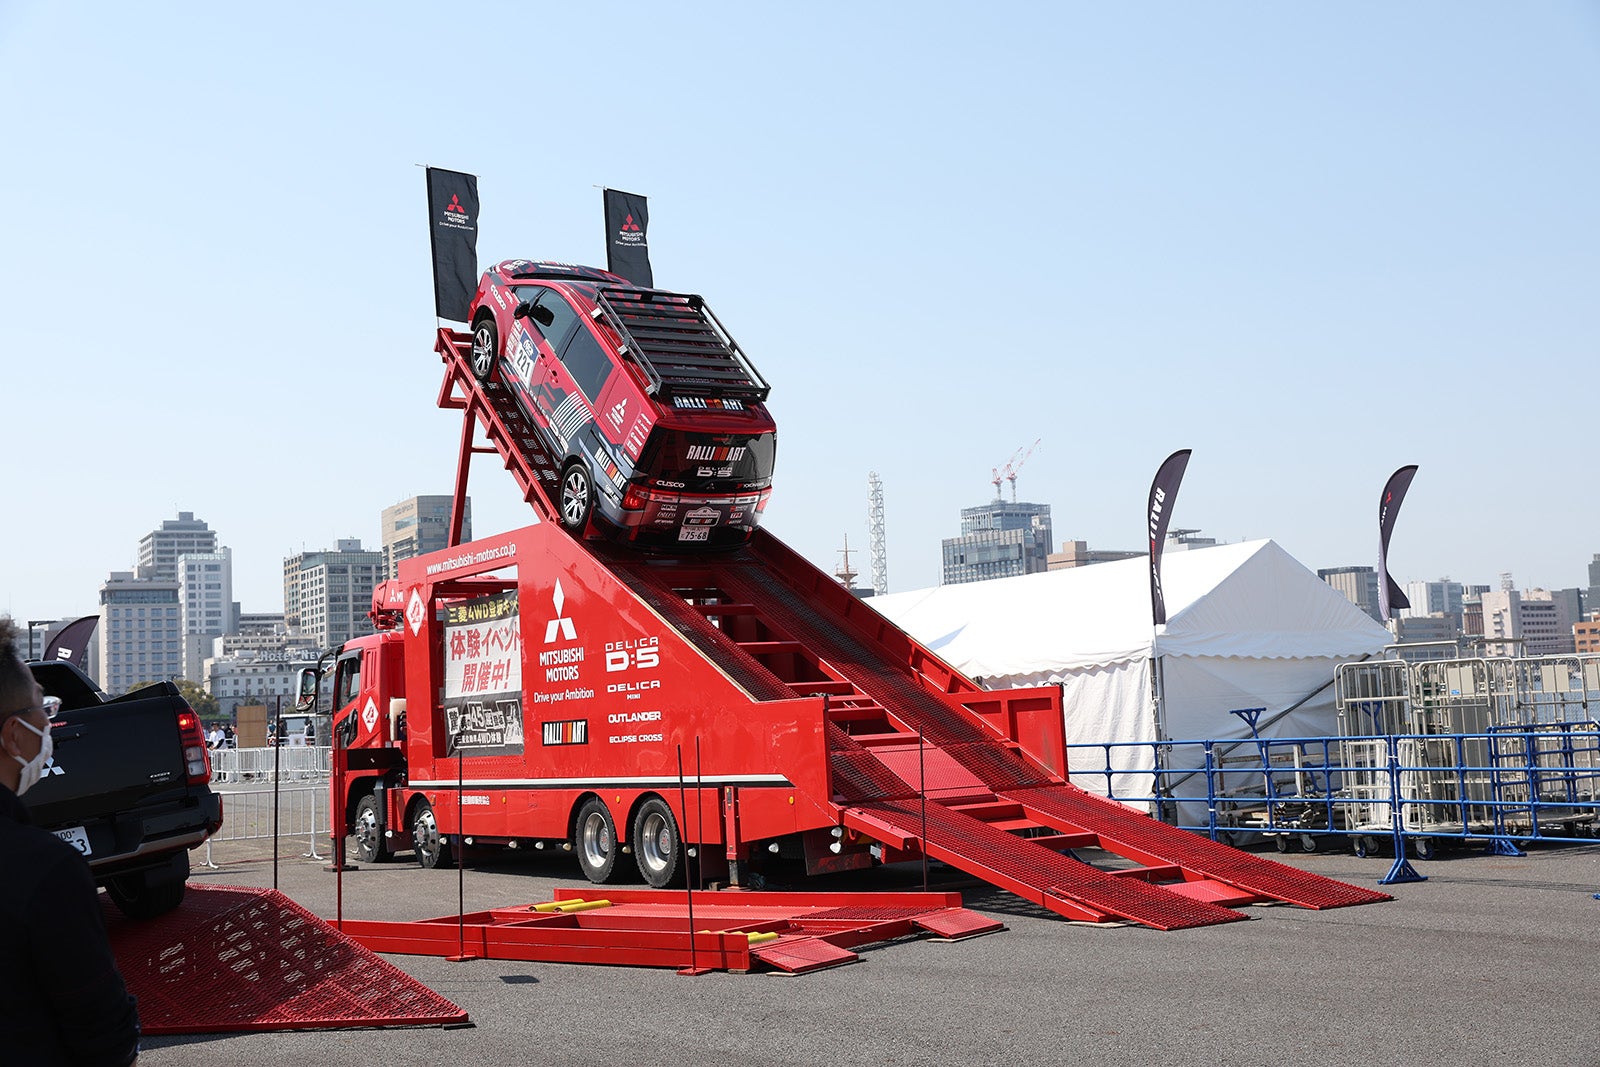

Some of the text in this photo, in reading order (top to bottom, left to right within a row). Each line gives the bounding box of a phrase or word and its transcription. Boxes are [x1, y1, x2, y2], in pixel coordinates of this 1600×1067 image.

[516, 349, 531, 378] 221
[656, 480, 686, 489] CUSCO
[685, 532, 708, 540] 75-68
[426, 541, 517, 575] www.mitsubishi-motors.co.jp
[605, 636, 659, 652] DELICA
[539, 646, 585, 667] MITSUBISHI
[605, 646, 660, 672] D:5
[546, 665, 580, 683] MOTORS
[607, 680, 661, 693] DELICA
[533, 687, 595, 705] Drive your Ambition
[608, 711, 662, 724] OUTLANDER
[609, 733, 663, 744] ECLIPSE CROSS
